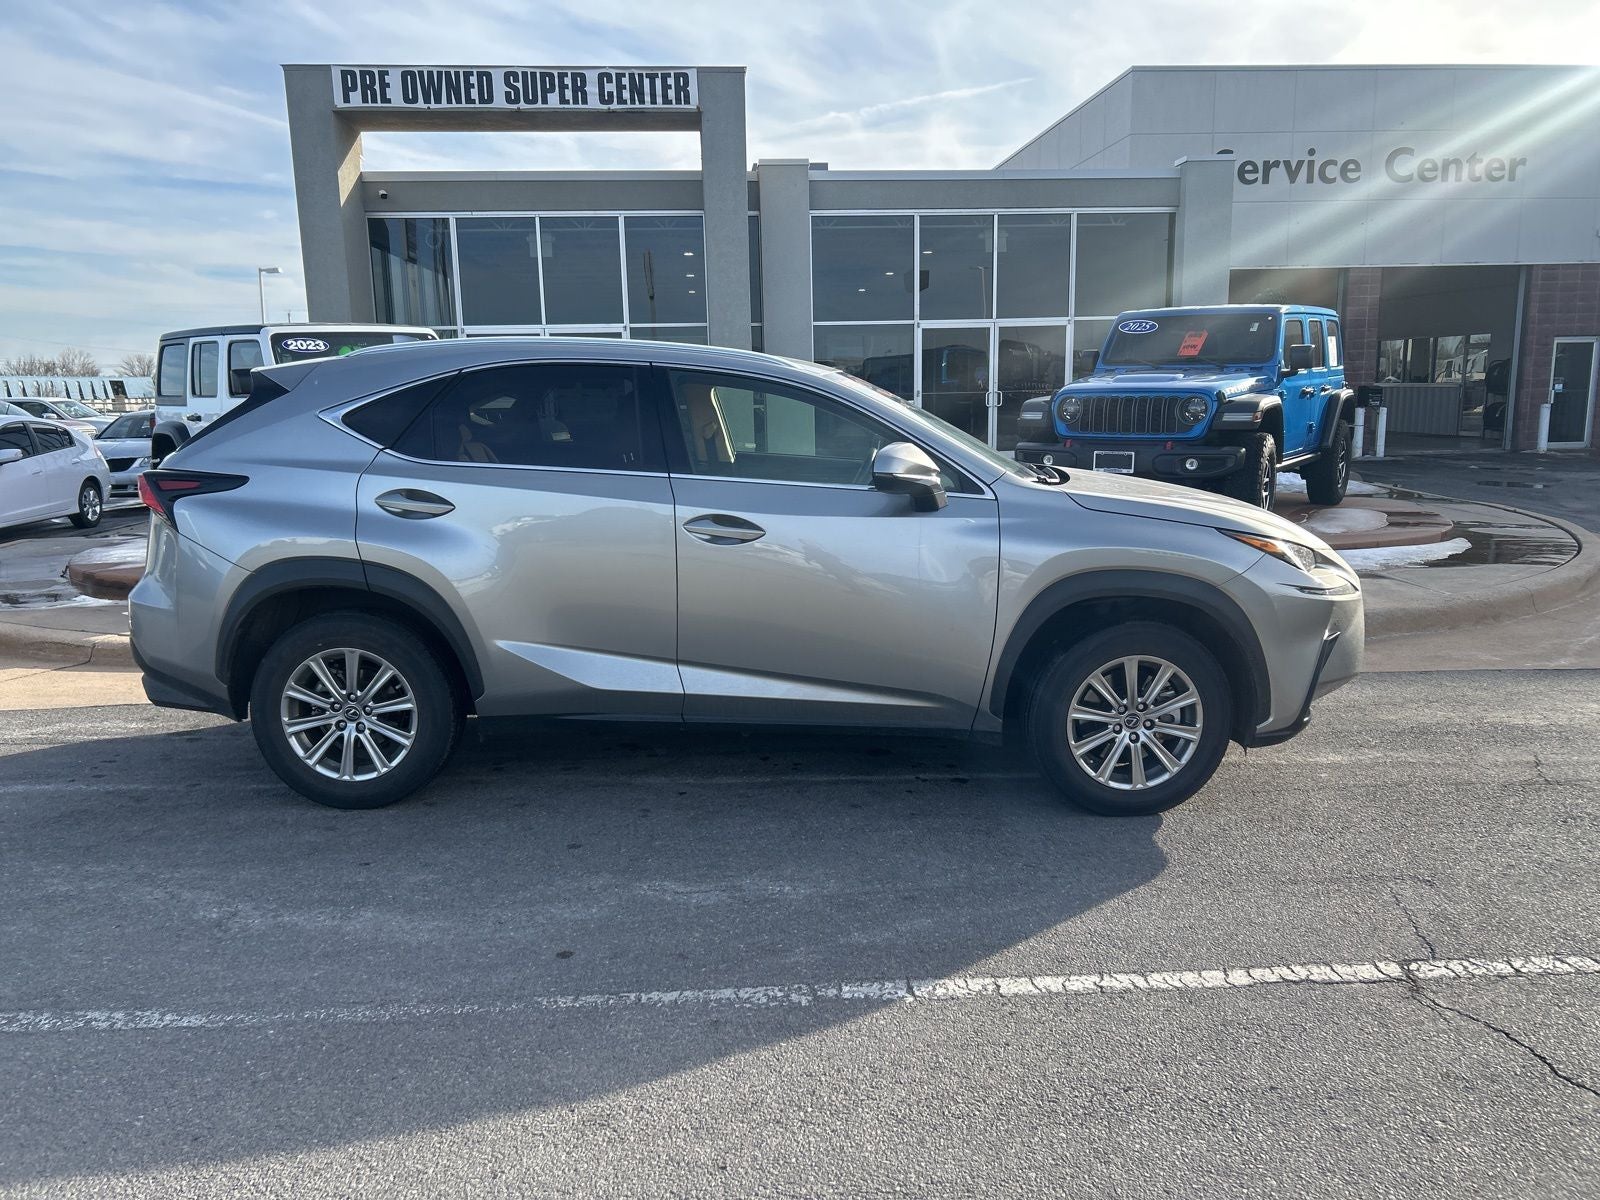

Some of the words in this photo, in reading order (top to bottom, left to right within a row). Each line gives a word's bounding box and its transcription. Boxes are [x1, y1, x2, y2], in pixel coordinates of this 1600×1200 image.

[340, 69, 392, 104] PRE
[401, 69, 495, 105] OWNED
[503, 71, 589, 105] SUPER
[597, 71, 691, 106] CENTER
[1215, 147, 1362, 185] ervice
[1384, 146, 1528, 184] Center
[1123, 322, 1154, 331] 2025
[287, 340, 326, 350] 2023
